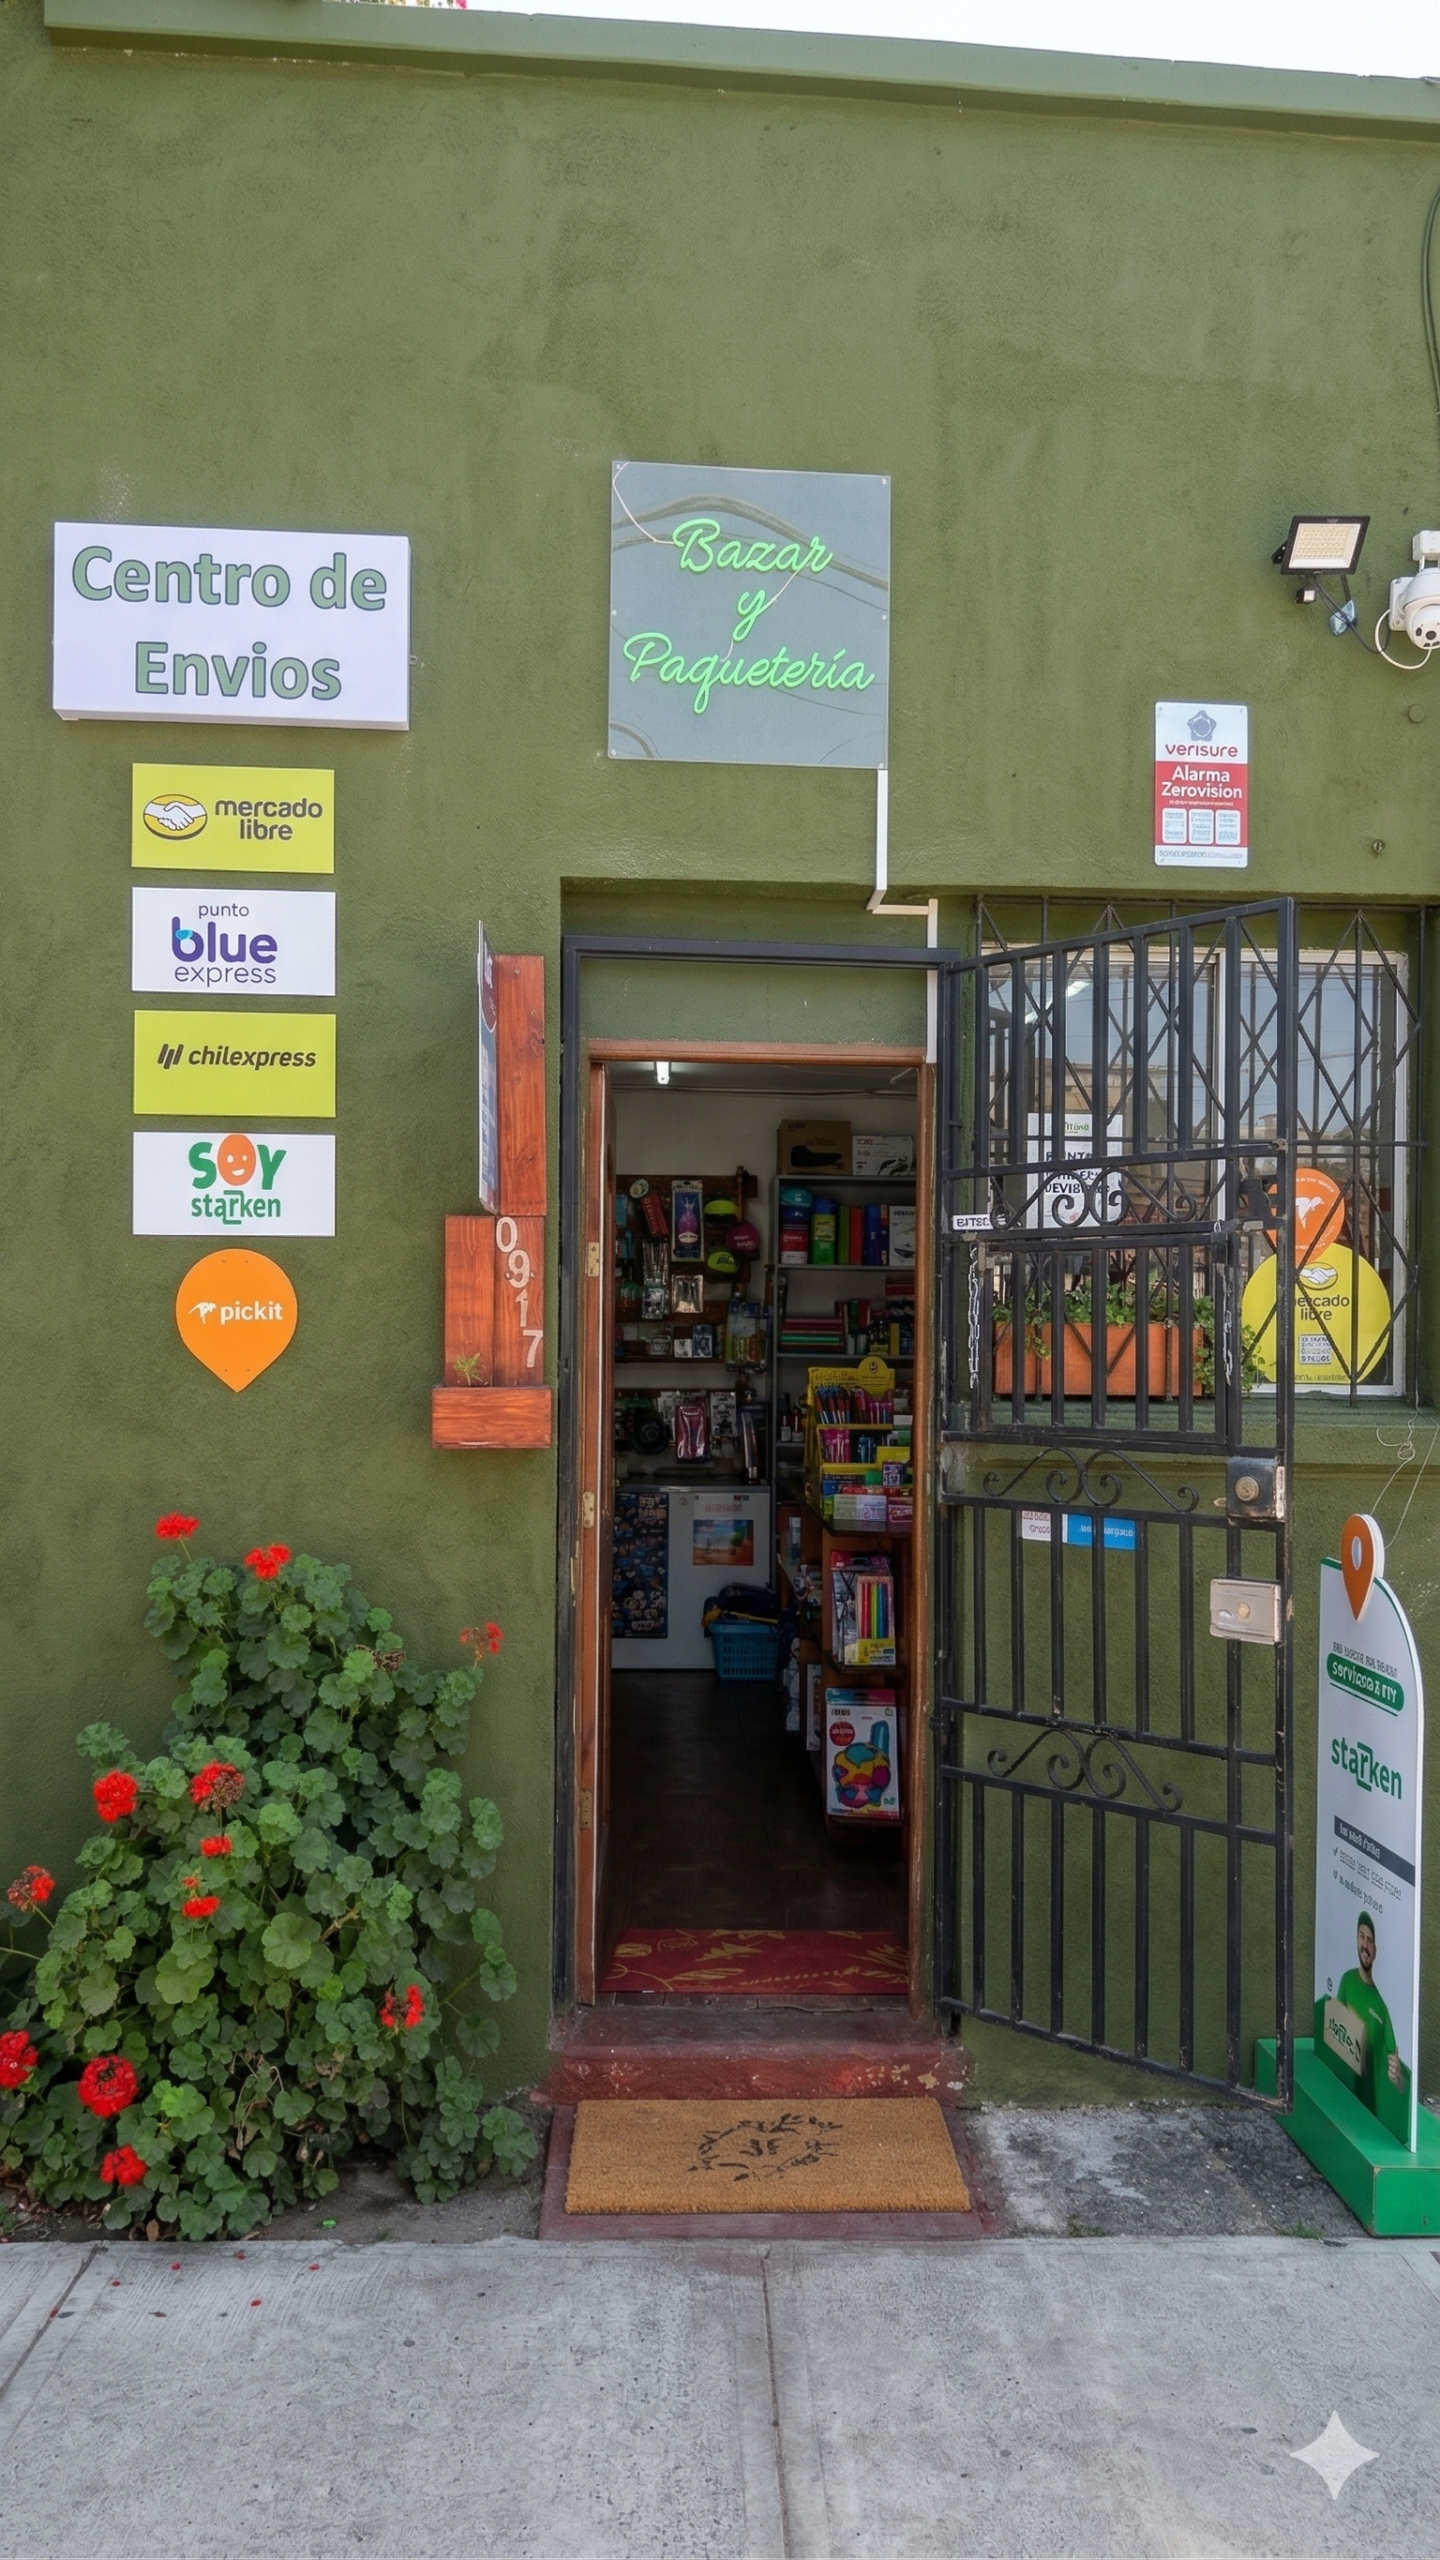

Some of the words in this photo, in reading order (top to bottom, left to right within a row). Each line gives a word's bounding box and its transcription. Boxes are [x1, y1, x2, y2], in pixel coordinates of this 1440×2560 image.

[672, 518, 833, 573] Bazar
[72, 545, 291, 607] Centro
[309, 552, 387, 611] de
[732, 589, 767, 642] y
[135, 641, 342, 700] Envios
[623, 632, 875, 714] Paquetería
[1165, 744, 1238, 757] verisure
[1172, 765, 1230, 782] Alarma
[1161, 782, 1242, 798] Zerovision
[215, 798, 323, 818] mercado
[240, 819, 293, 840] libre
[198, 903, 250, 919] punto
[171, 916, 278, 964] blue
[174, 966, 277, 987] express
[188, 1045, 317, 1071] chilexpress
[188, 1133, 287, 1190] SOY
[191, 1190, 281, 1224] starken
[220, 1300, 283, 1325] pickit
[1295, 1294, 1350, 1307] ercado
[1331, 1736, 1402, 1800] starken
